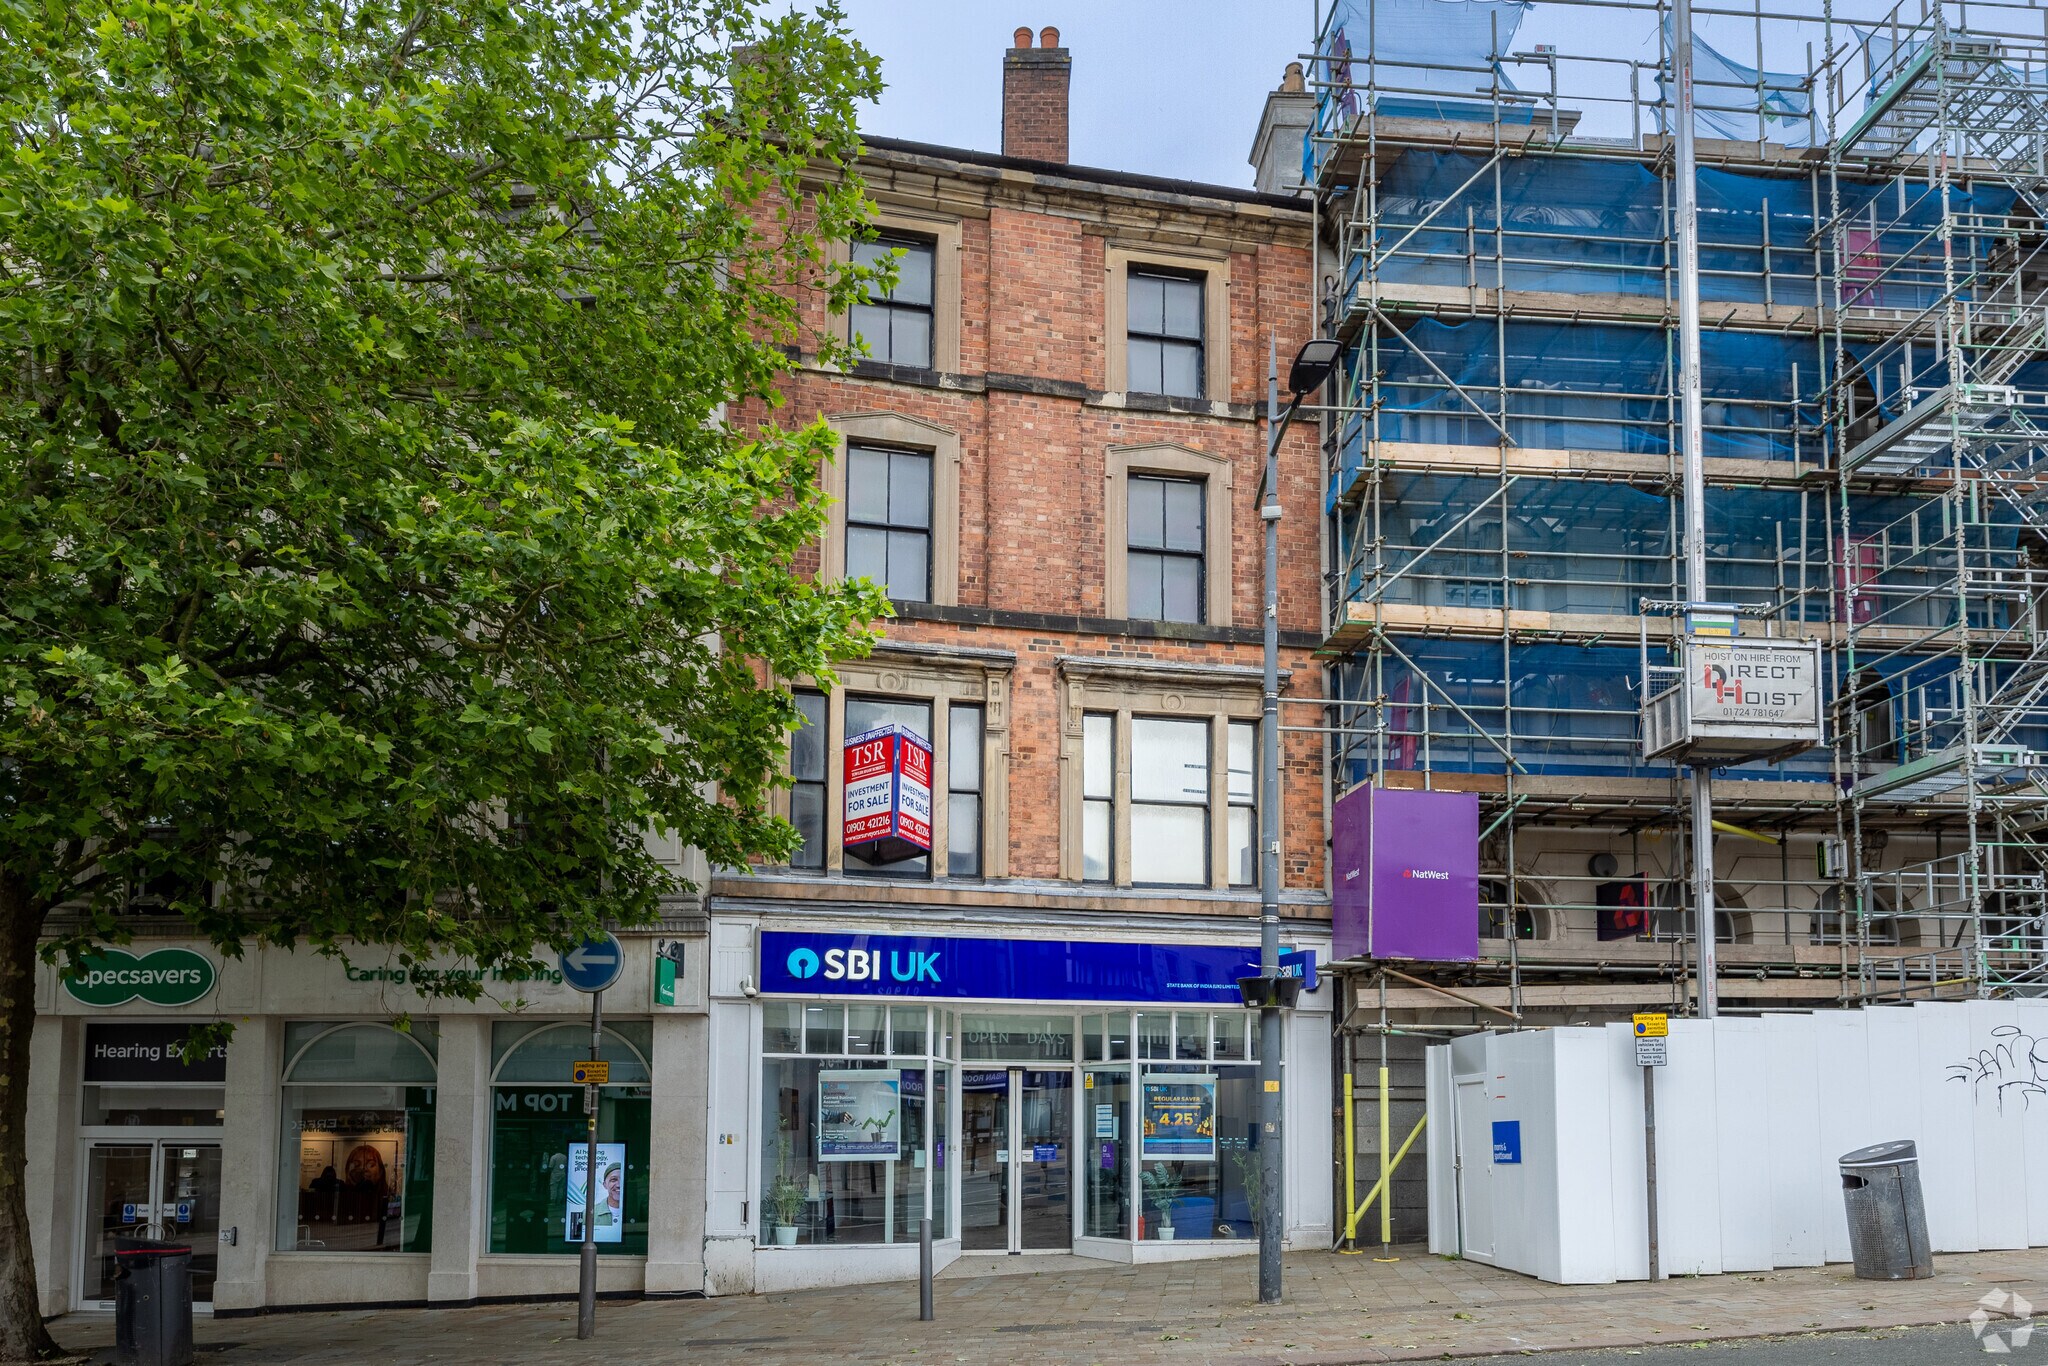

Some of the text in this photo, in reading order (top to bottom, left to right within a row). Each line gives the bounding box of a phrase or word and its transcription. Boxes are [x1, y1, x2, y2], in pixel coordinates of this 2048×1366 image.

[1704, 652, 1731, 661] HOIST
[1750, 654, 1771, 662] HIRE
[1774, 655, 1800, 663] FROM
[1704, 664, 1800, 688] DIRECT
[1717, 679, 1802, 705] HOIST
[1723, 708, 1784, 717] 01724 781647
[845, 733, 865, 746] BUSINESS
[852, 741, 885, 766] TSR
[905, 742, 926, 772] TSR
[848, 781, 889, 798] INVESTMENT
[902, 782, 928, 802] INVESTMENT
[848, 794, 889, 812] FOR SALE
[902, 795, 928, 816] FOR SALE
[846, 815, 890, 834] 01902 421216
[900, 816, 914, 830] 01902
[1412, 870, 1449, 879] NatWest
[824, 949, 941, 982] SBI UK
[347, 966, 406, 984] Caring
[493, 966, 563, 984] haring
[969, 1032, 1065, 1044] OPEN DAYS
[95, 1043, 227, 1061] Hearing Exrt
